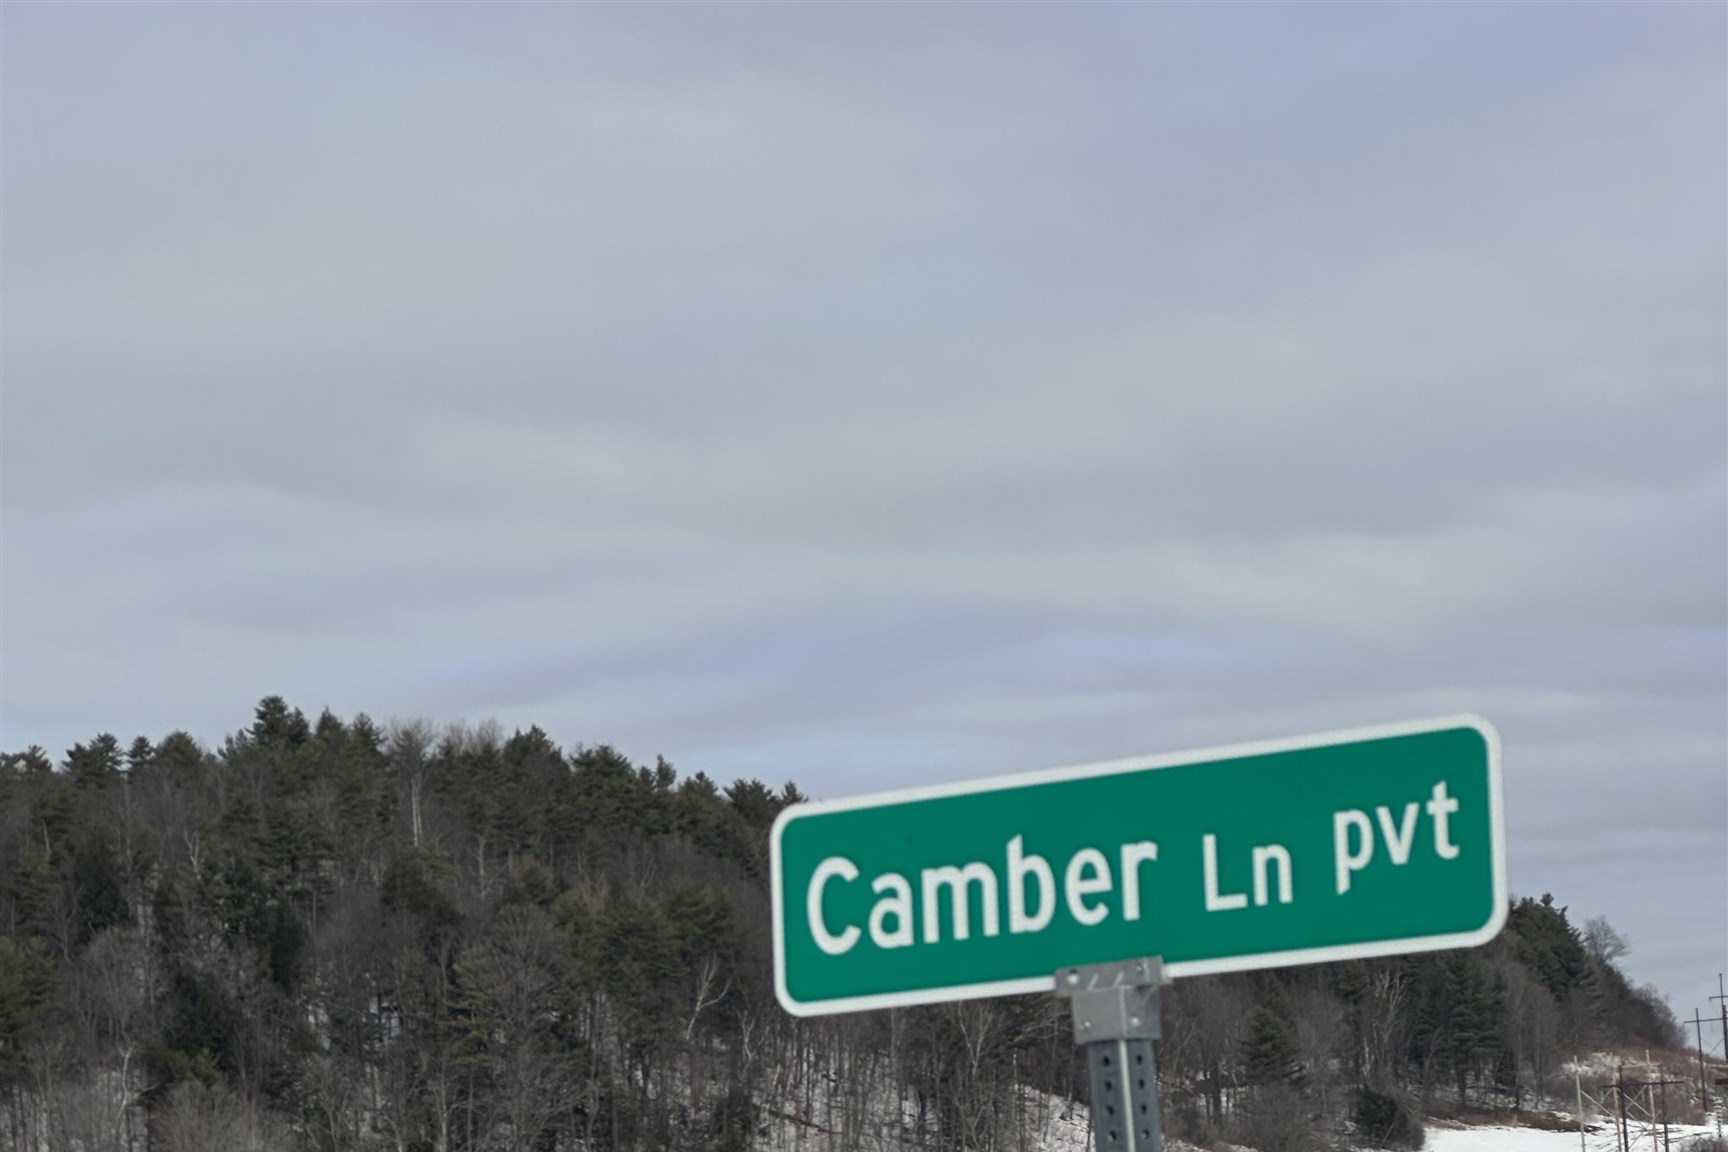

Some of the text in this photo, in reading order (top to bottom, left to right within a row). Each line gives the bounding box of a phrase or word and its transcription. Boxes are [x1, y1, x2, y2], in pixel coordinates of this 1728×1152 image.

[806, 780, 1460, 955] Camber Ln pvt
